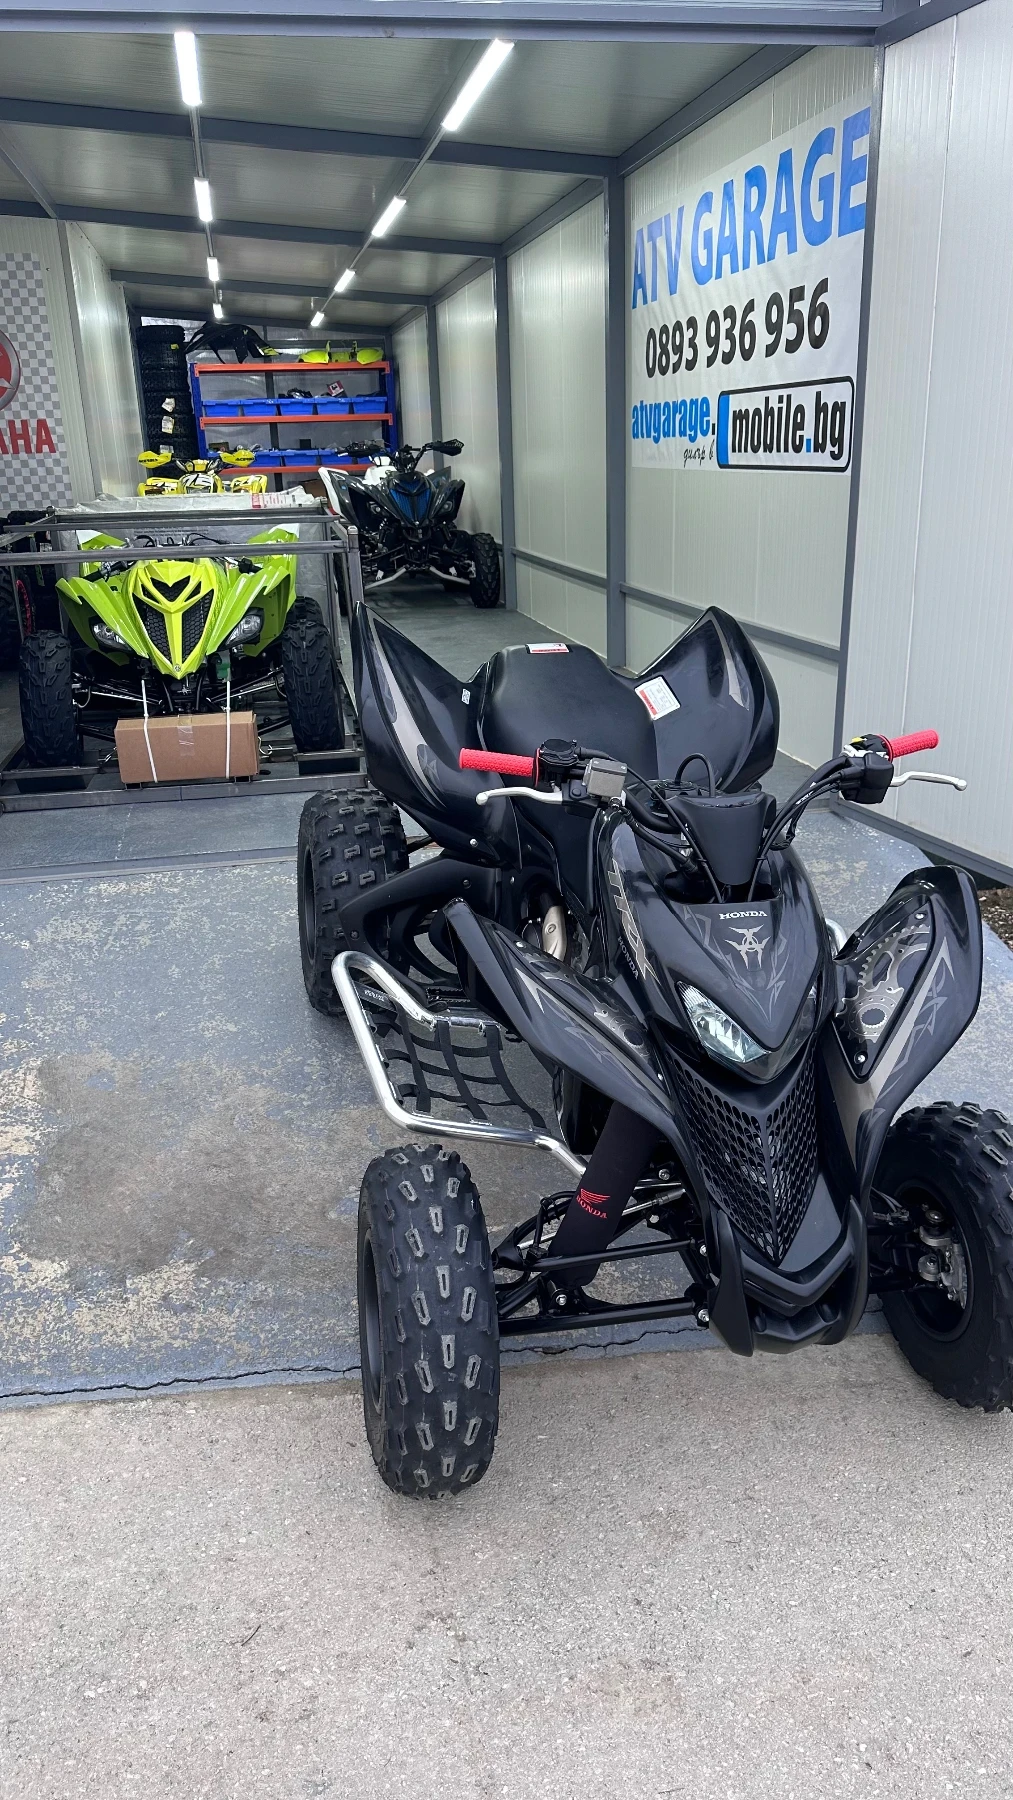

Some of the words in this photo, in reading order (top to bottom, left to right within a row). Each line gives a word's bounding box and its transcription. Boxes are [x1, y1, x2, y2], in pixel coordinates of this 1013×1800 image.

[632, 205, 685, 310] ATV
[691, 106, 871, 286] GARAGE
[645, 315, 699, 379] 0893
[705, 298, 756, 369] 936
[765, 278, 830, 358] 956
[731, 391, 846, 461] mobile.bg
[719, 910, 768, 920] HONDA
[617, 935, 639, 980] HONDA
